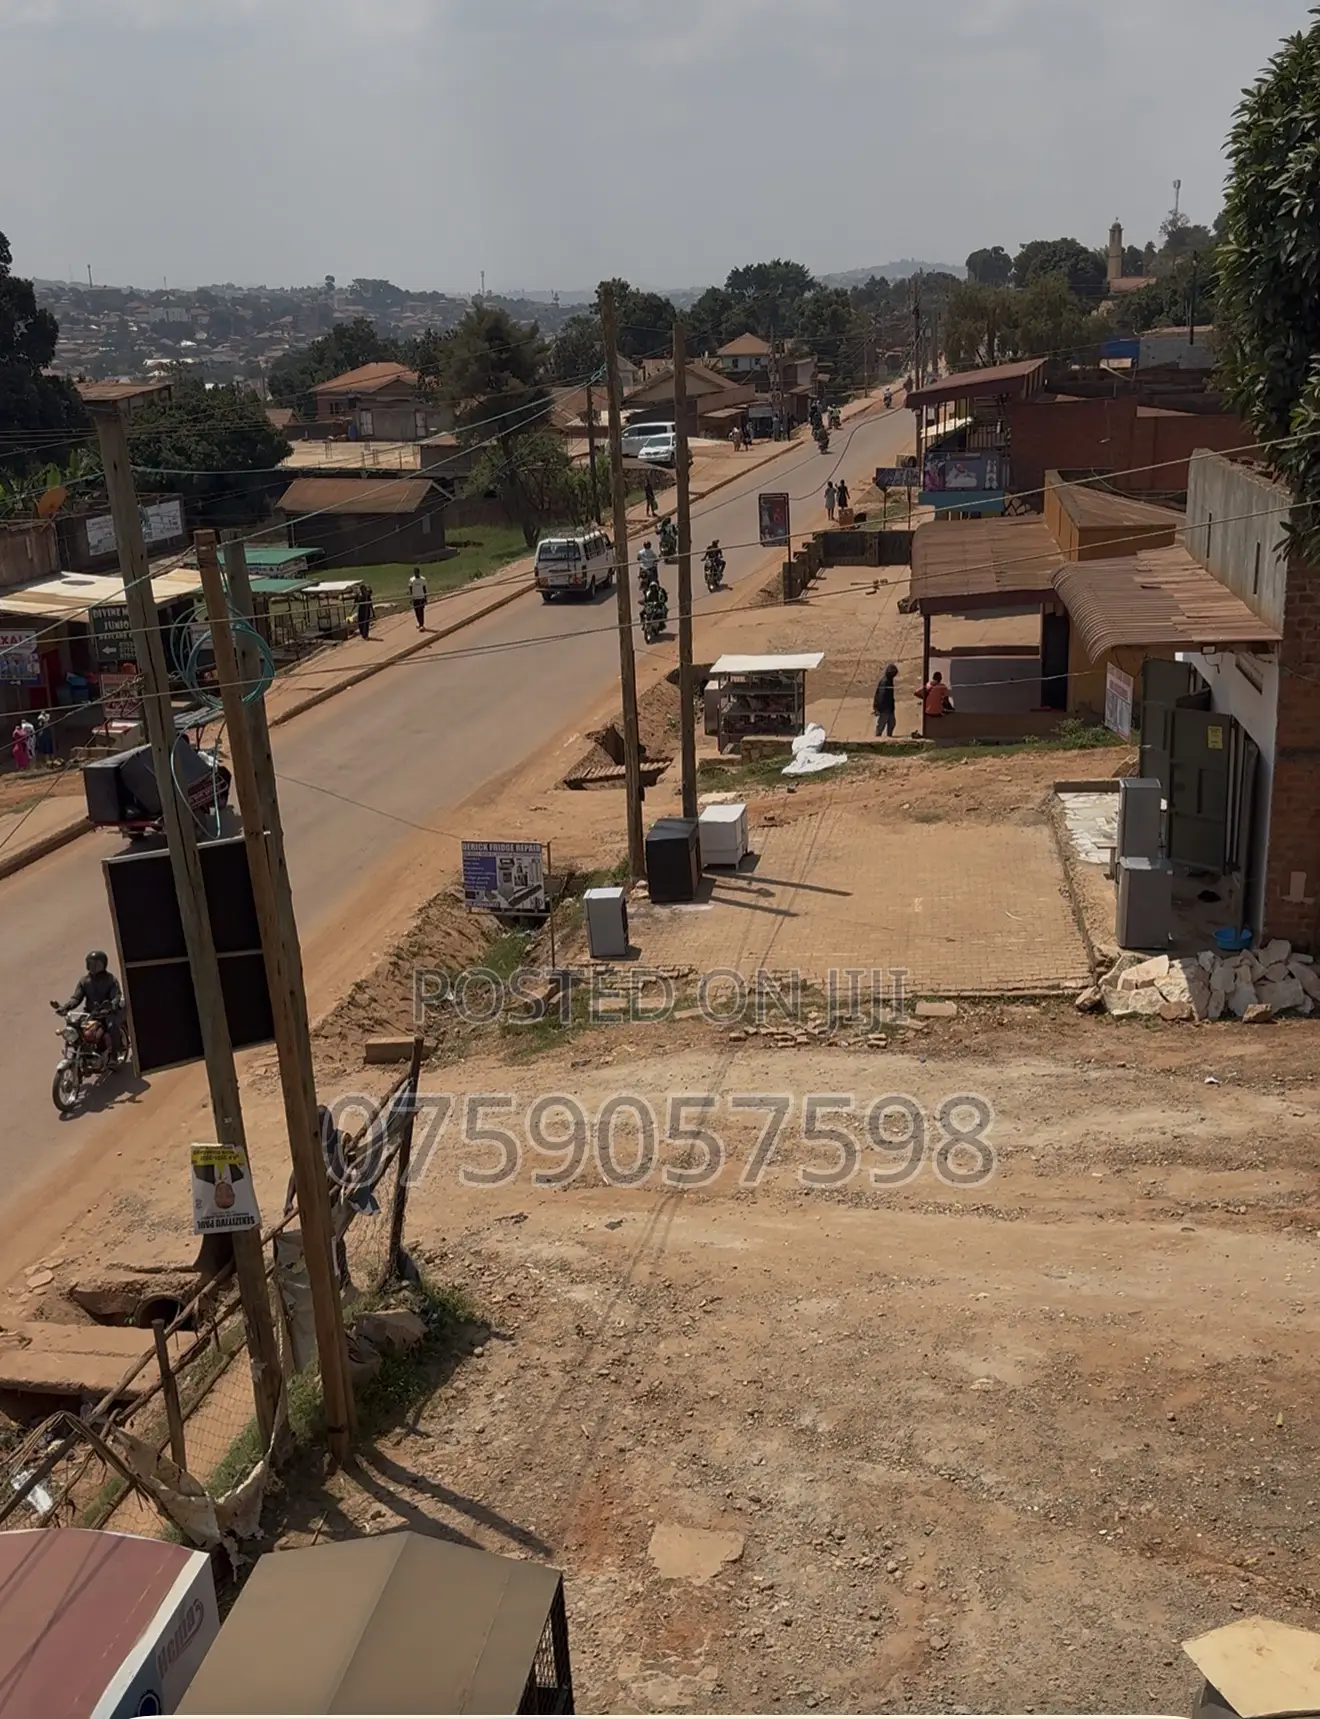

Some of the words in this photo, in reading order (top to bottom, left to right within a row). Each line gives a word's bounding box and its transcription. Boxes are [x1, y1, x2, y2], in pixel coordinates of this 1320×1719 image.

[92, 607, 121, 619] DIVINE
[104, 620, 130, 631] JUNIO
[489, 843, 514, 852] FRIDGE
[515, 844, 541, 853] REPAIR
[196, 1220, 215, 1230] PAUL
